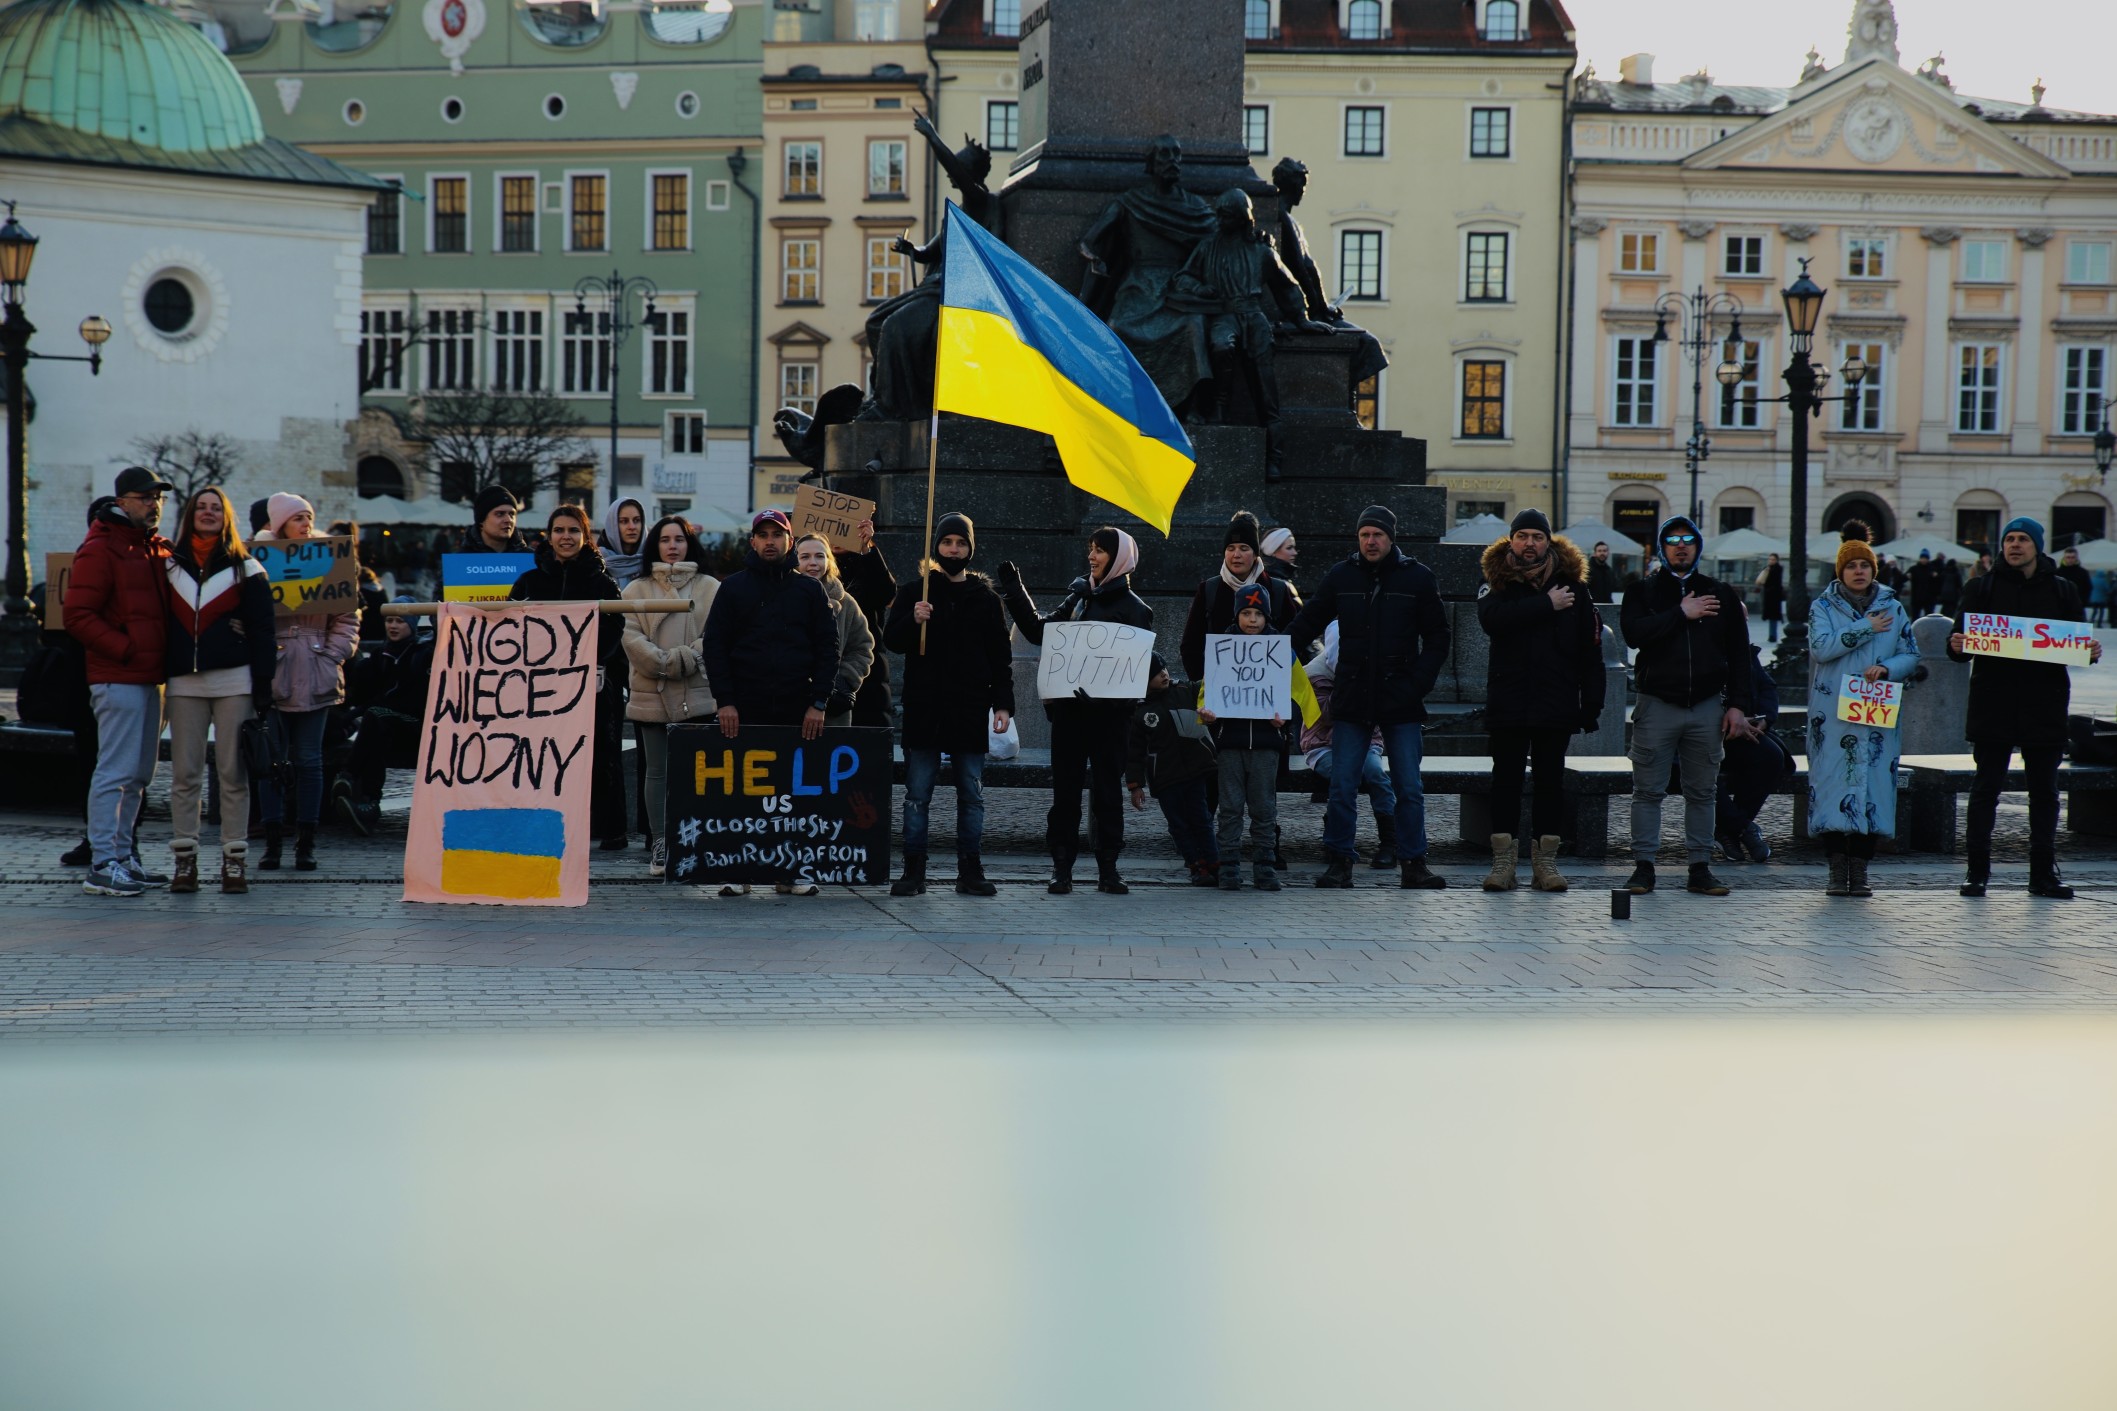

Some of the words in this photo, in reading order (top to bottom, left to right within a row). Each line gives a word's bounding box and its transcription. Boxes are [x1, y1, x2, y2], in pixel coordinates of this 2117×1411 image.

[812, 490, 860, 513] STOP
[466, 565, 517, 574] SOLIDARNI
[299, 580, 352, 601] WAR
[1969, 614, 2009, 628] BAN
[447, 609, 594, 668] NIGDY
[1052, 624, 1136, 650] STOP
[1215, 638, 1283, 668] FUCK
[1047, 649, 1148, 687] PUTIN
[1231, 666, 1265, 682] YOU
[433, 665, 589, 729] WIĘCEJ
[1221, 685, 1274, 708] PUTIN
[1848, 679, 1893, 698] CLOSE
[1861, 695, 1886, 707] THE
[1847, 702, 1892, 724] SKY
[425, 725, 587, 796] WOJNY
[695, 745, 860, 796] HELP
[762, 794, 793, 813] US
